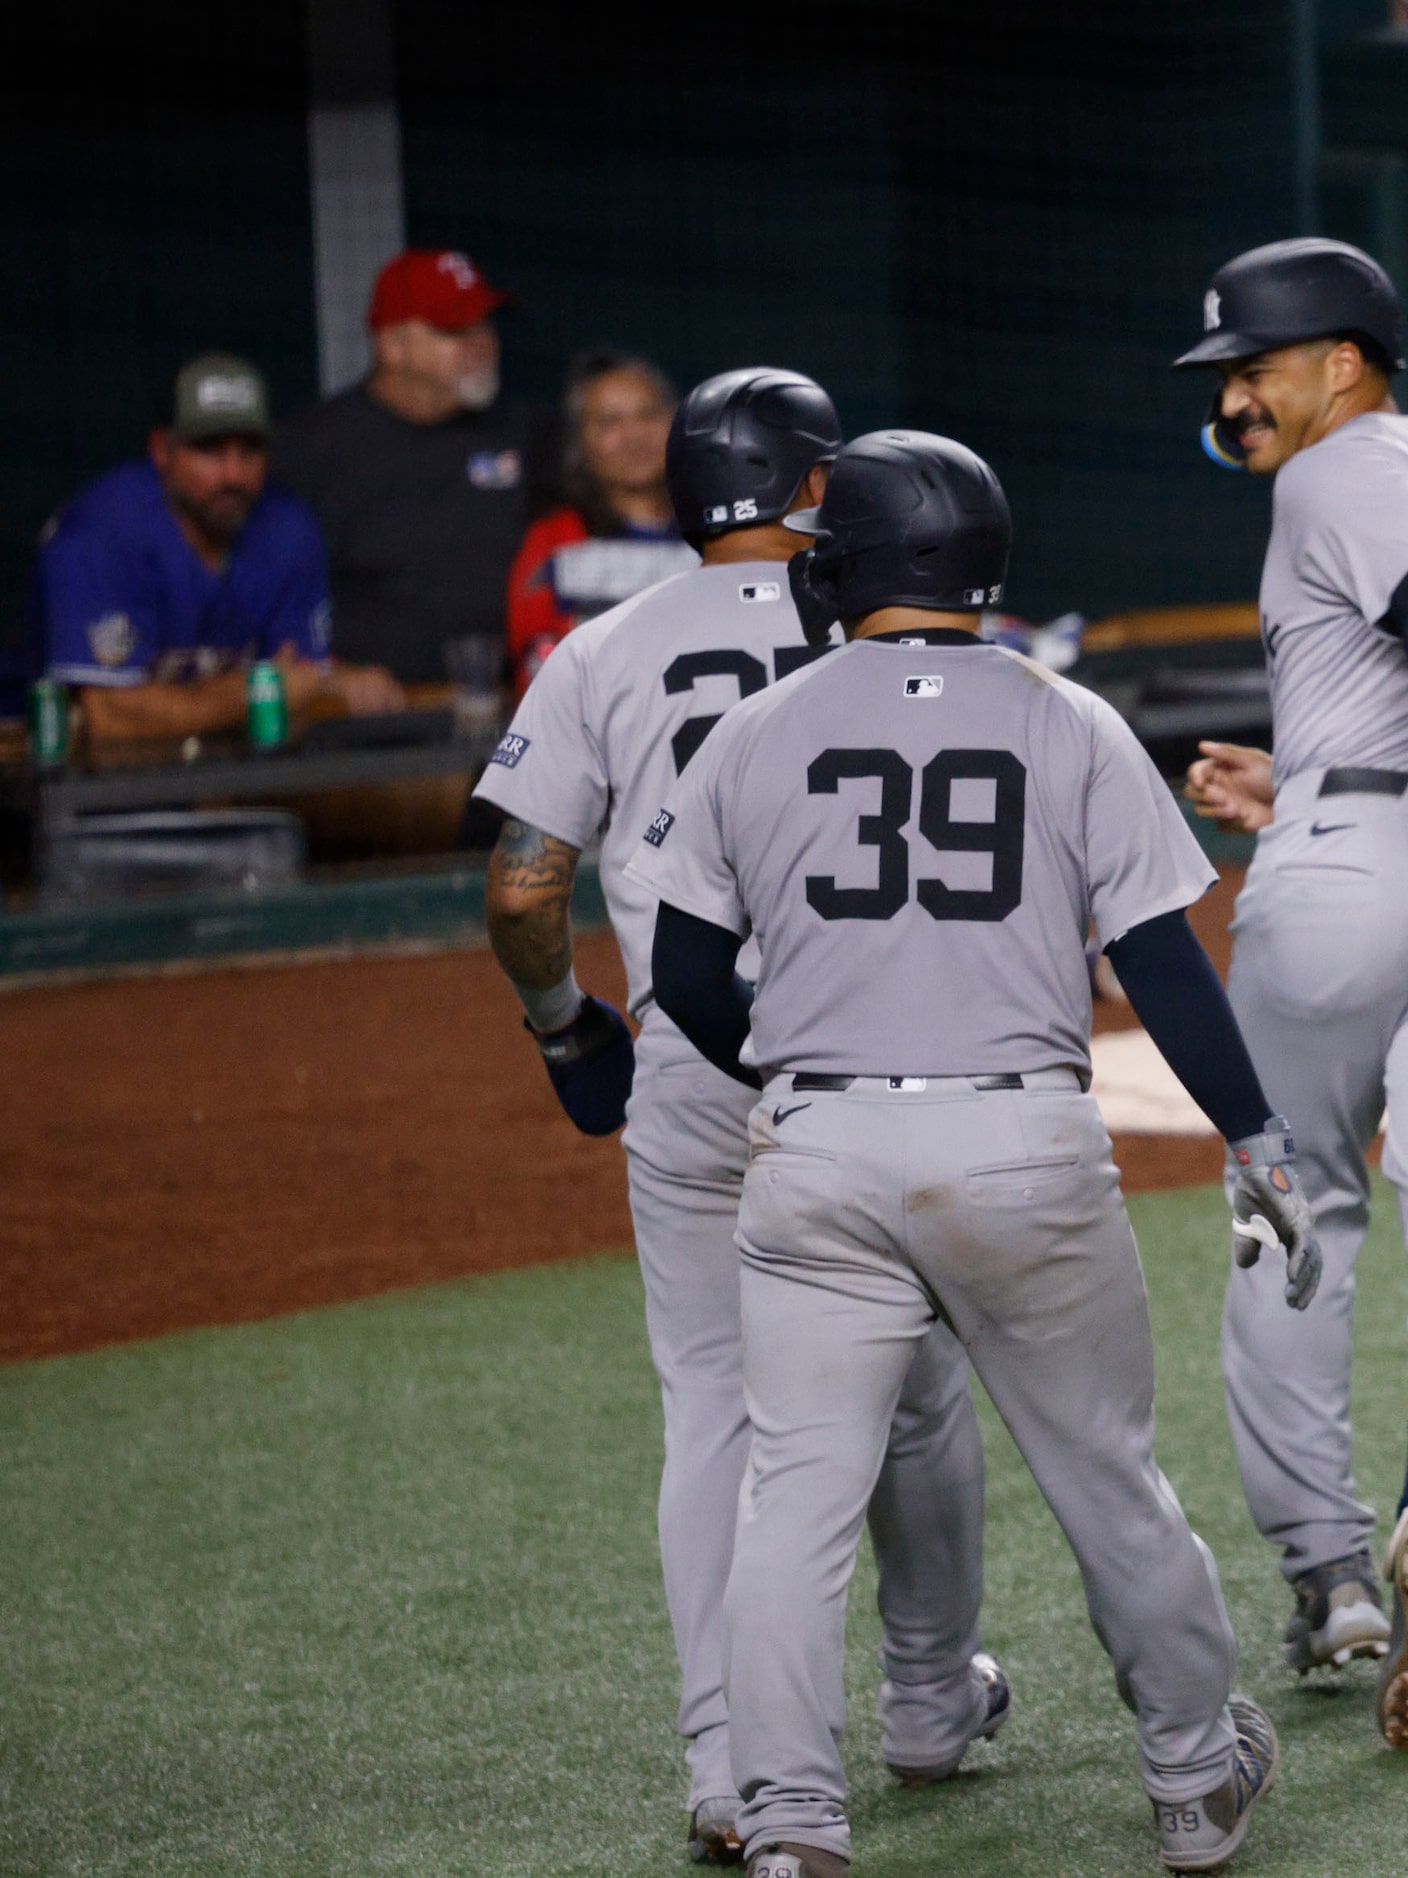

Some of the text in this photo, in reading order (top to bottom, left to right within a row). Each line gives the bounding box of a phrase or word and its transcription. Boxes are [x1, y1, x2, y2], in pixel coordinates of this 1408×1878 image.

[733, 498, 758, 521] 25
[987, 584, 1002, 604] 3
[663, 644, 842, 779] 2
[806, 748, 1027, 922] 39
[1163, 1811, 1199, 1833] 39
